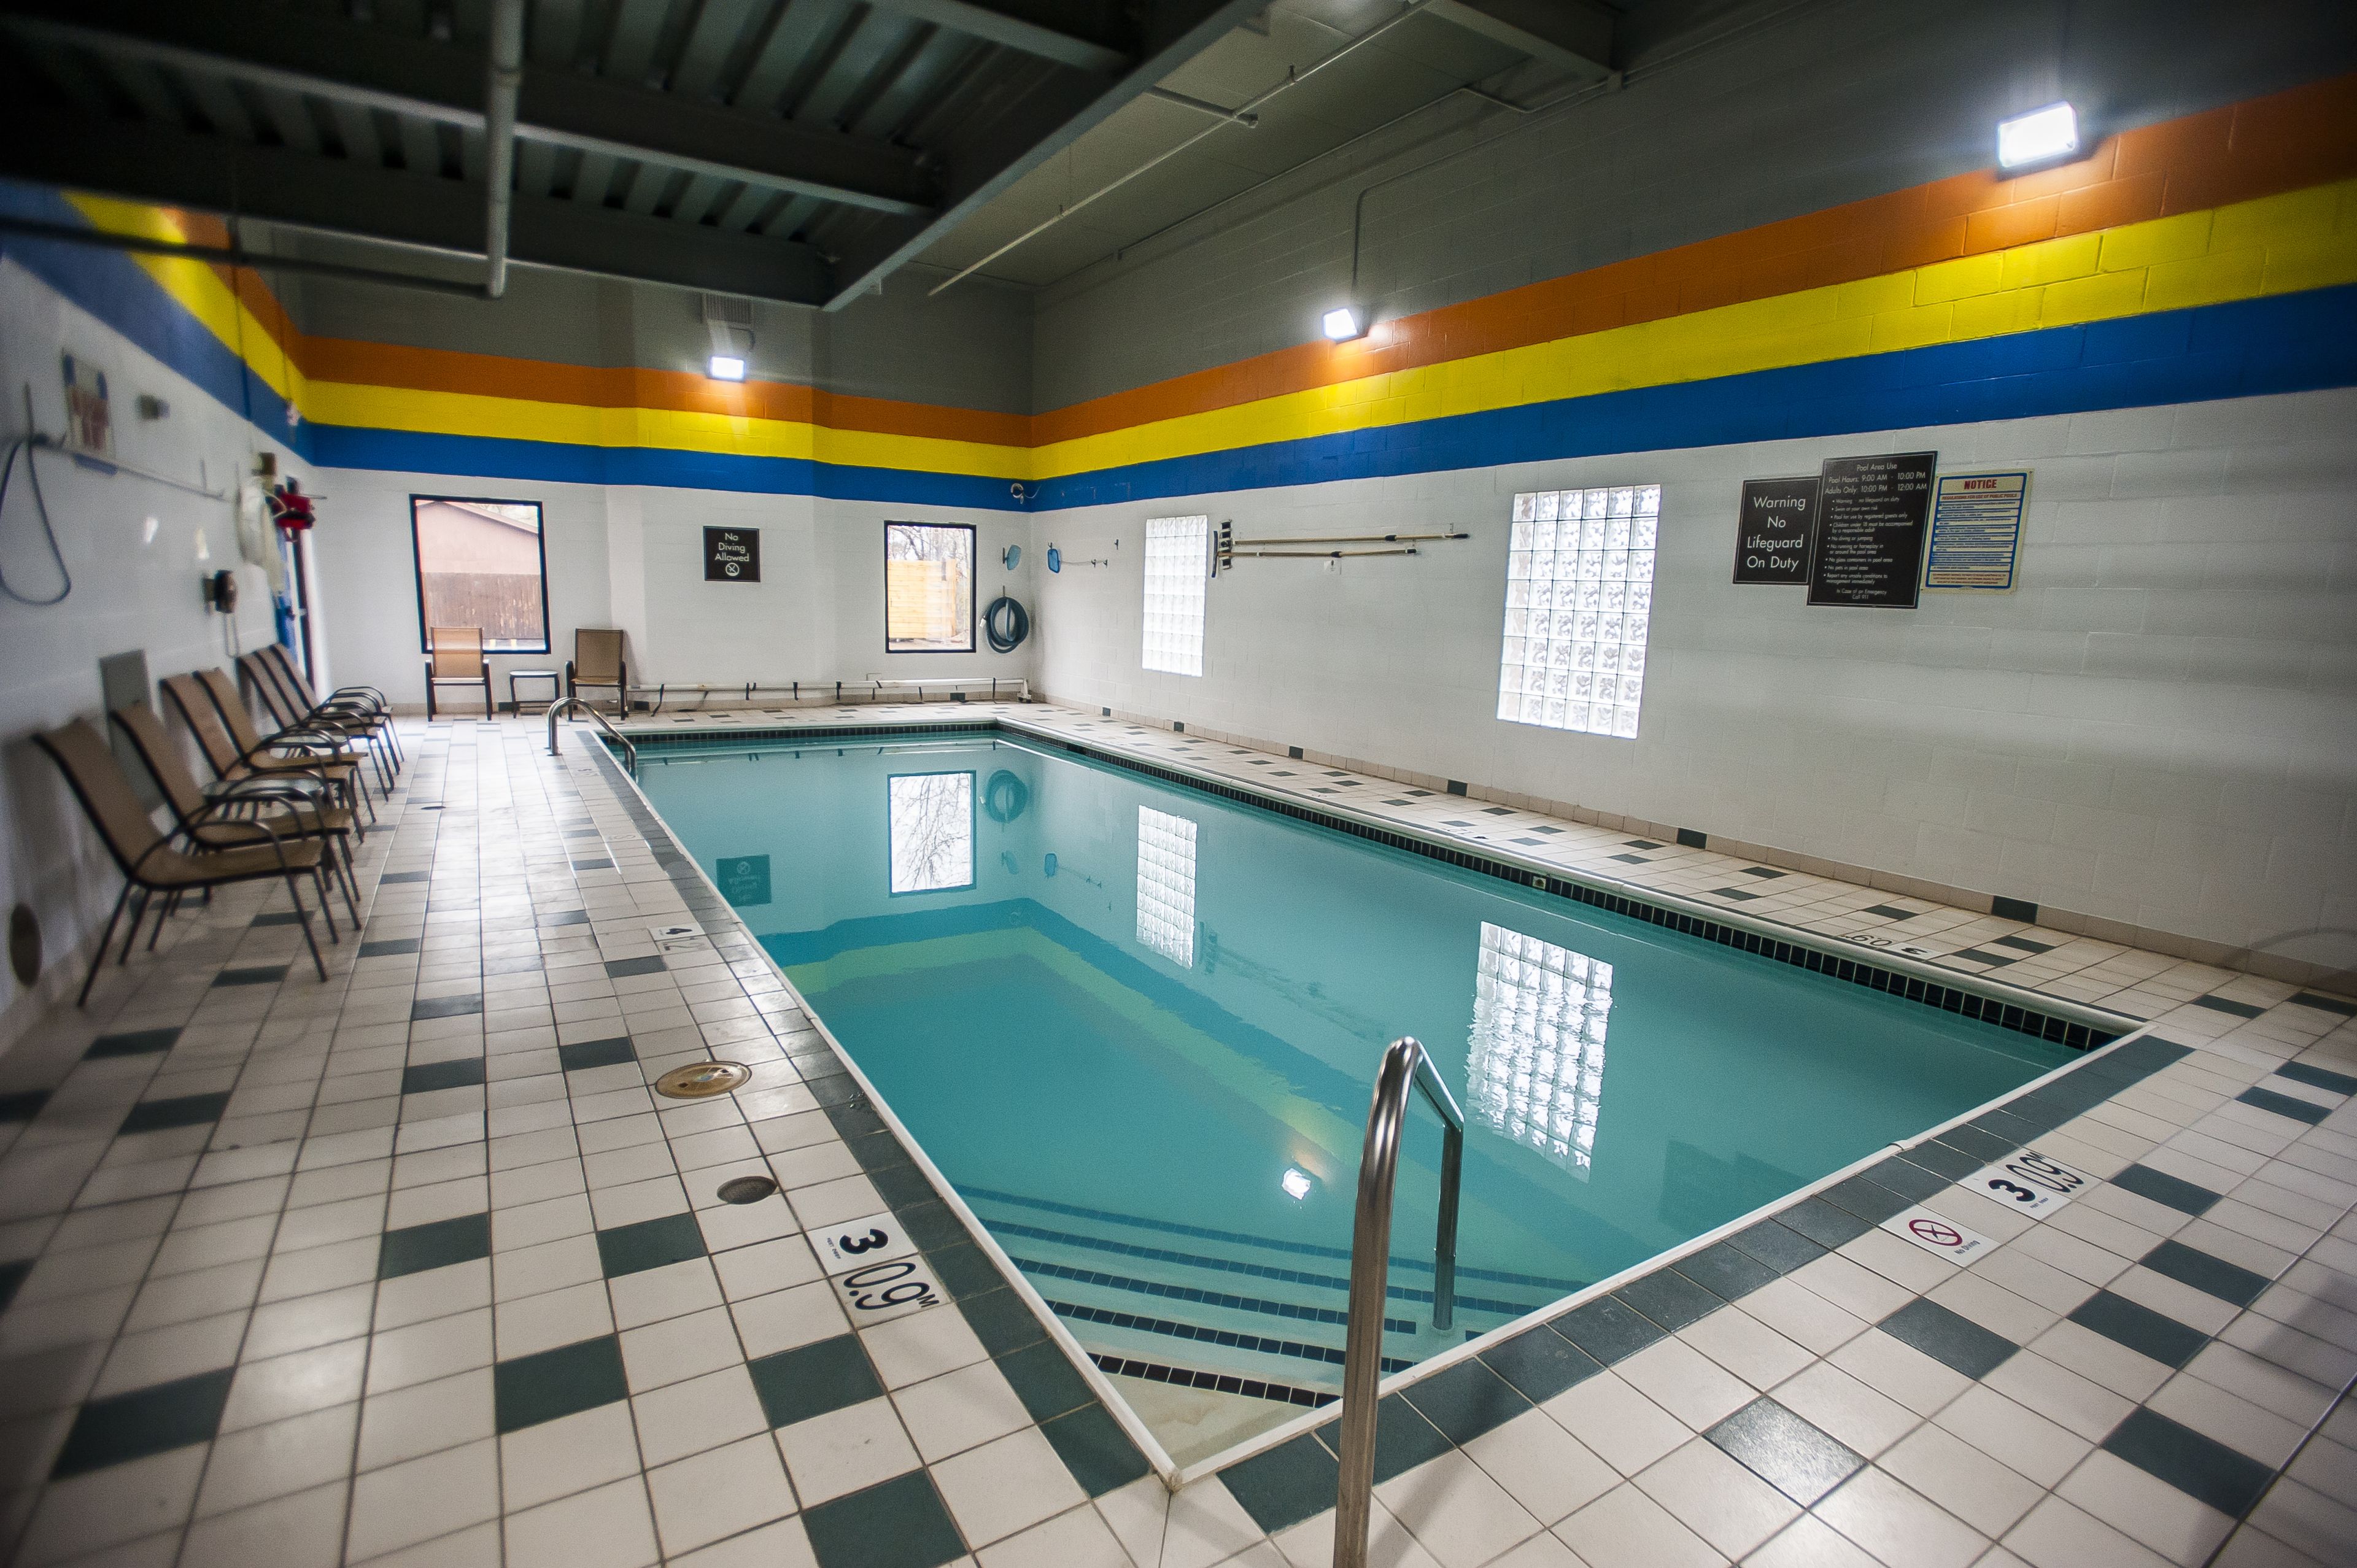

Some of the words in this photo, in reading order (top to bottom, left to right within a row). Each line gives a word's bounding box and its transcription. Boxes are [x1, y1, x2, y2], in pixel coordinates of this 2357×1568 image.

[1857, 463, 1868, 471] Pool
[1964, 479, 1997, 490] NOTICE
[1754, 495, 1806, 511] Warning
[1767, 516, 1786, 528] No
[719, 543, 745, 554] Diving
[1747, 534, 1803, 552] Lifeguard
[714, 552, 749, 562] Allowed
[1747, 556, 1765, 568] On
[1770, 556, 1799, 572] Duty
[1988, 1179, 2035, 1202] 3
[839, 1229, 888, 1254] 3
[1961, 1240, 1980, 1250] Diving
